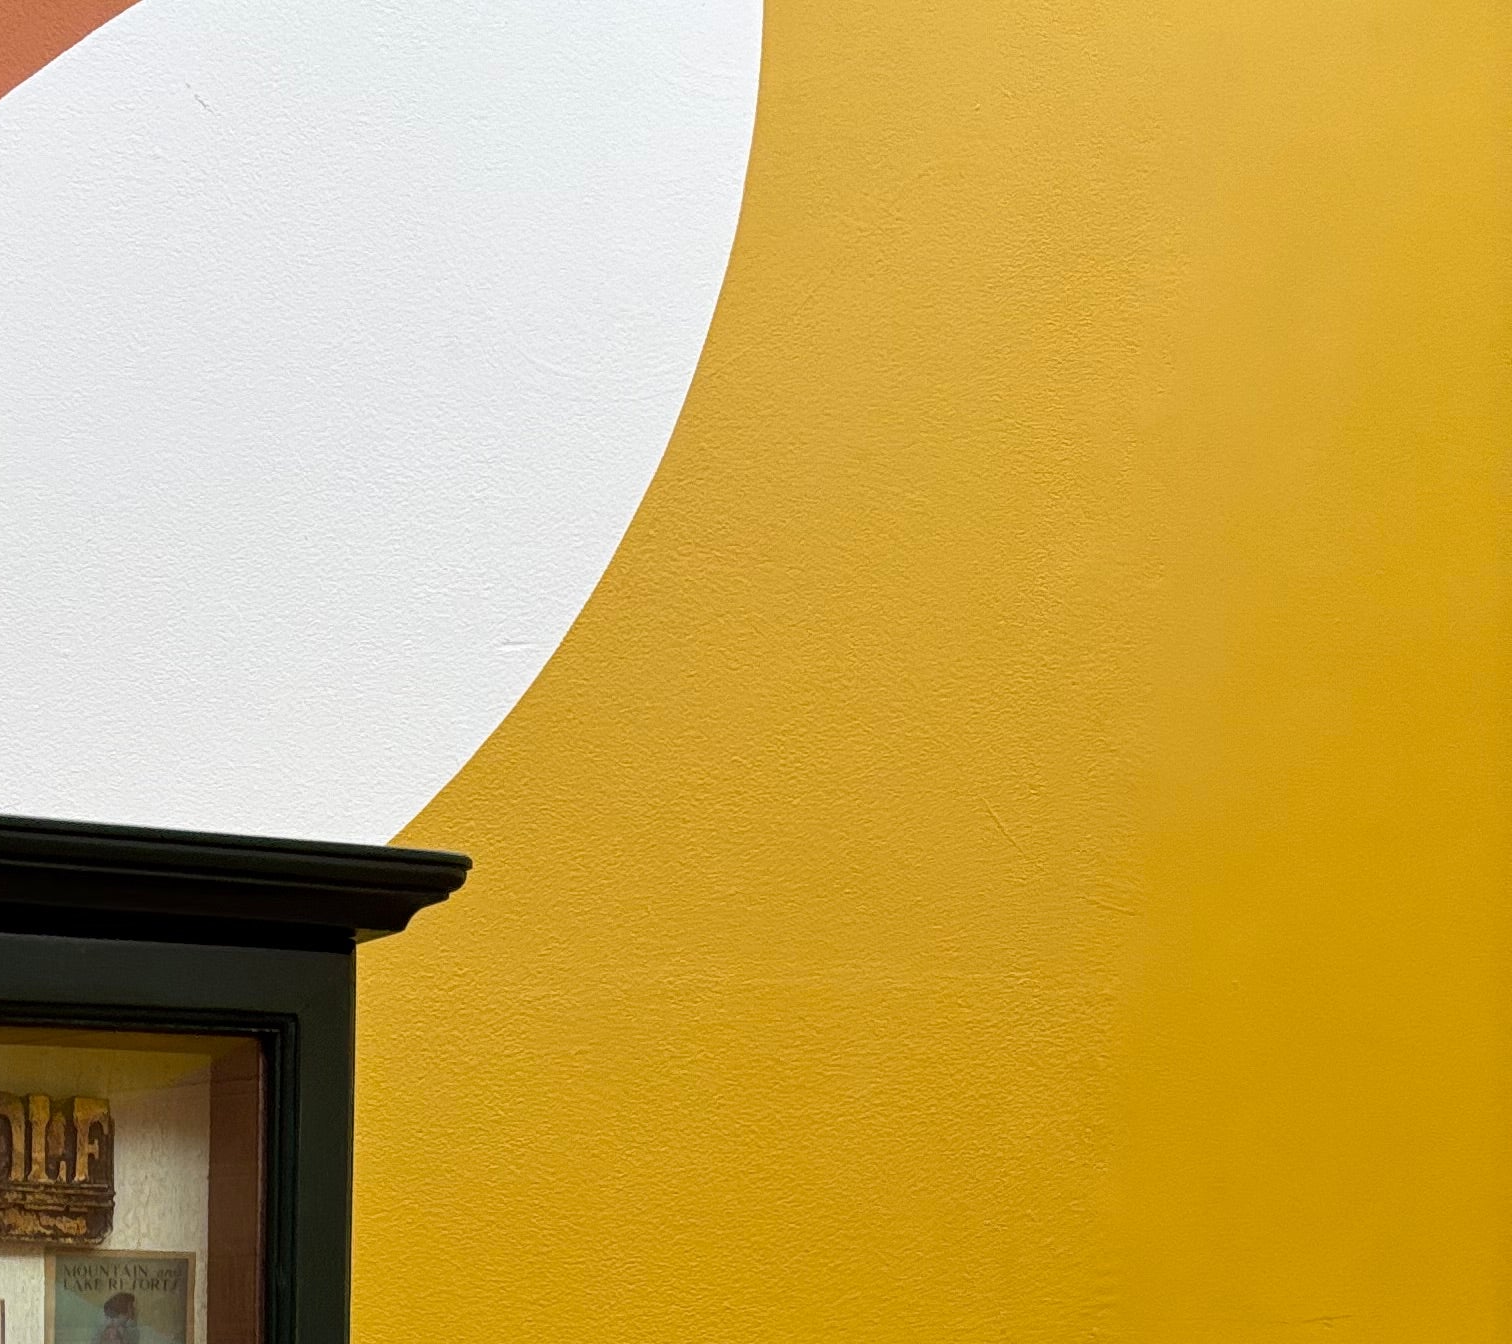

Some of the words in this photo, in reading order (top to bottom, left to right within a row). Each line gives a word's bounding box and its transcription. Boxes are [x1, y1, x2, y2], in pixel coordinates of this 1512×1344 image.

[63, 1263, 148, 1278] MOUNTAIN
[63, 1278, 100, 1291] LAKE
[108, 1278, 179, 1291] RESORTS
